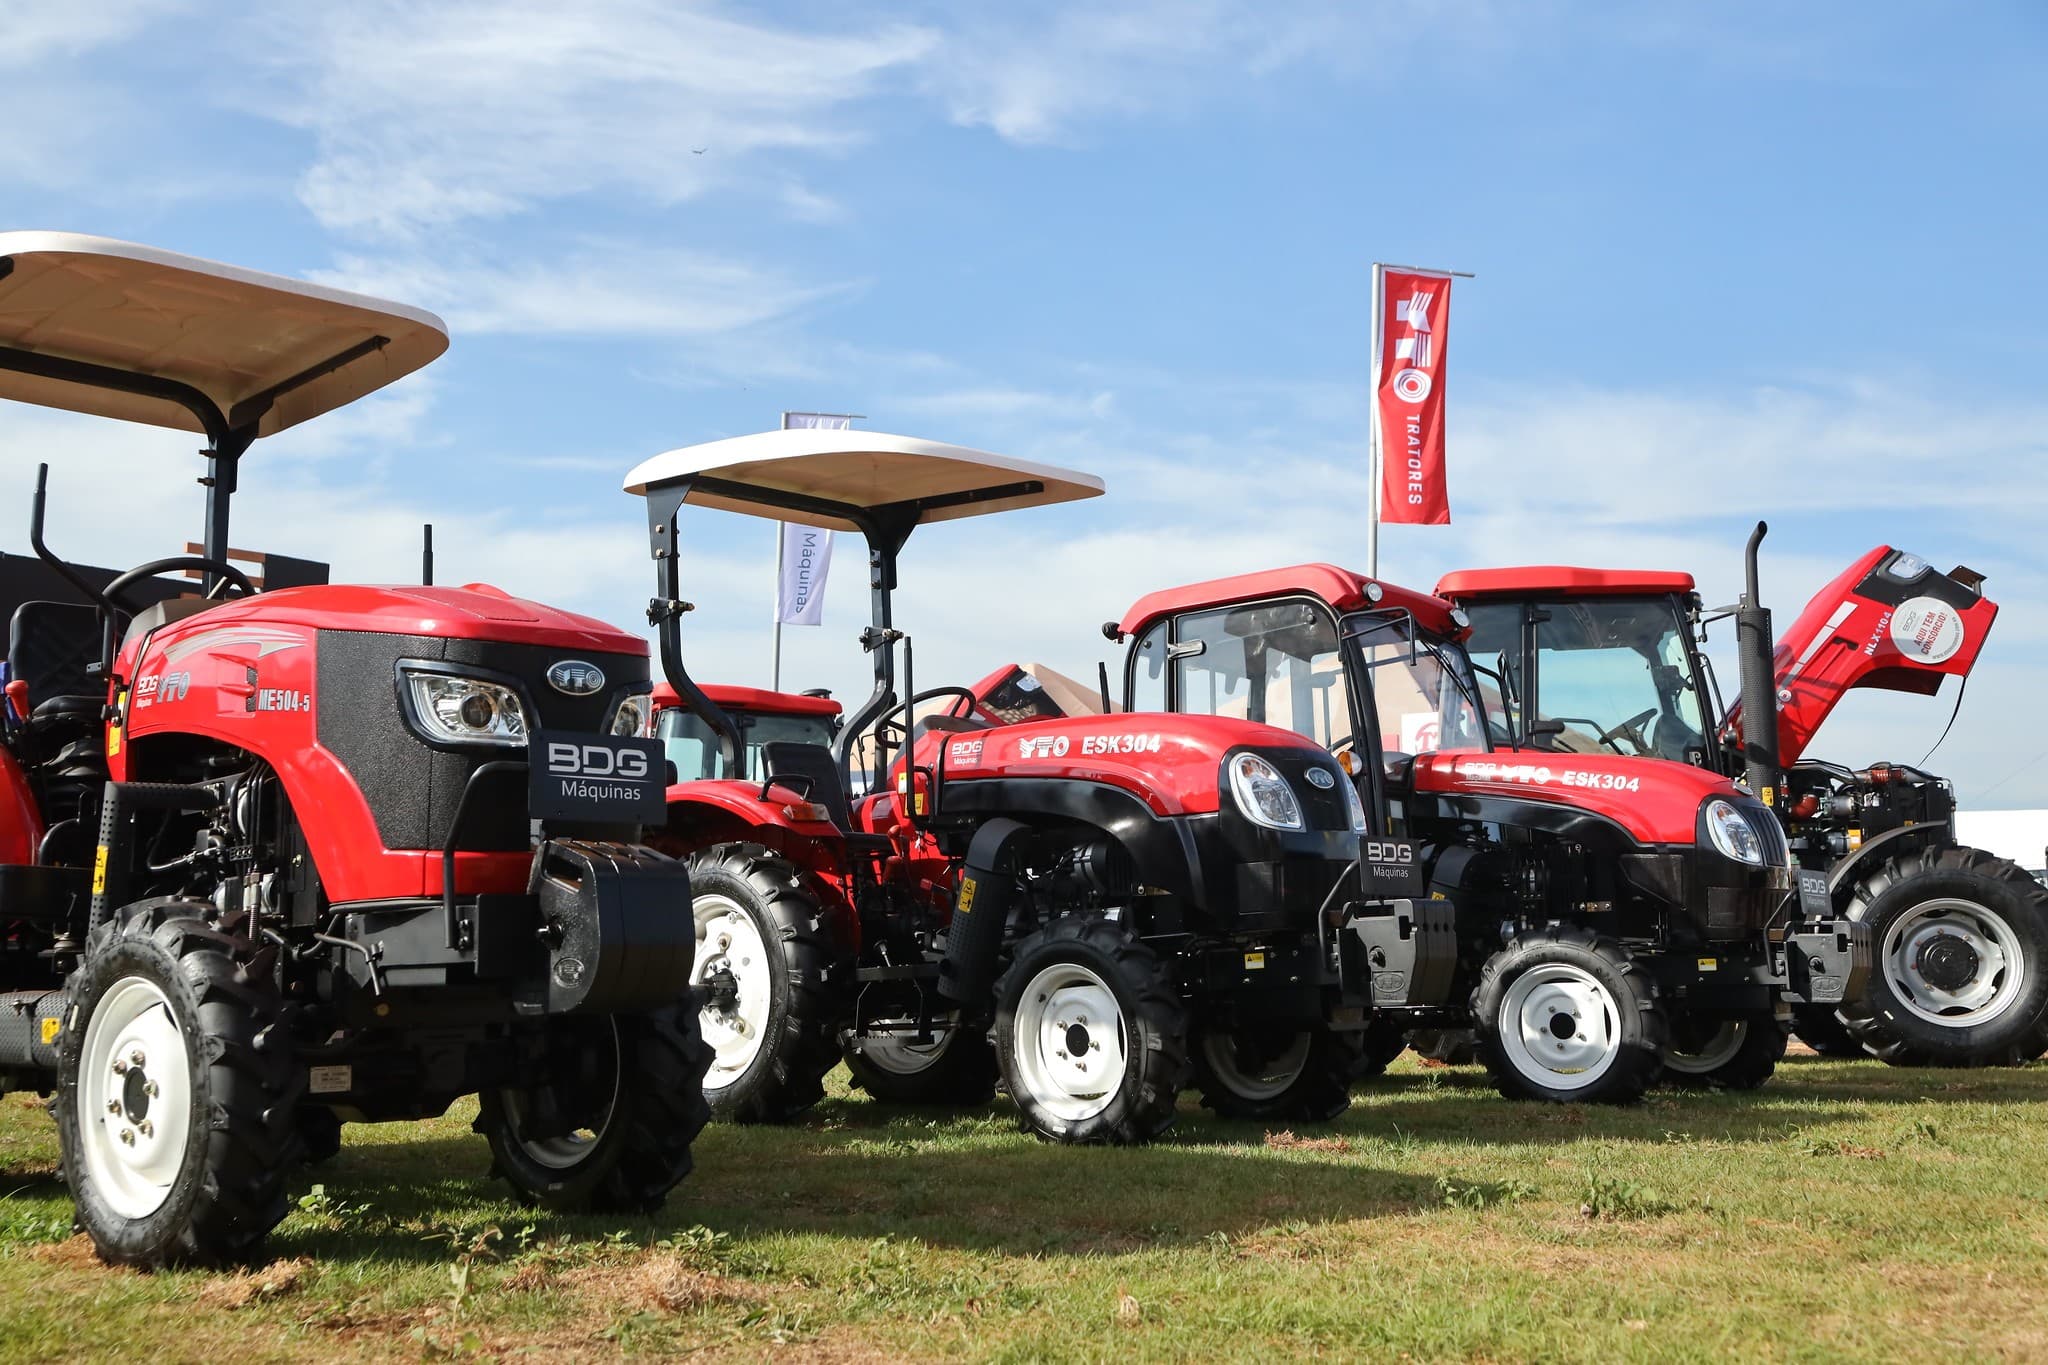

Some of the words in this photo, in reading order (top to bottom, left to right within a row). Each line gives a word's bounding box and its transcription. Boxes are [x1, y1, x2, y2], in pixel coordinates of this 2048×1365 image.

[1393, 291, 1433, 403] YTO
[1406, 414, 1422, 505] TRATORES
[795, 533, 816, 614] Máquinas
[1864, 611, 1892, 655] NLX1104
[1914, 627, 1928, 646] AQUI
[1923, 611, 1936, 628] TEM
[156, 672, 190, 703] YTO
[258, 689, 310, 712] ME504-5
[952, 740, 983, 755] BDG
[1019, 736, 1069, 758] YTO
[1082, 734, 1160, 755] ESK304
[549, 743, 647, 776] BDG
[562, 780, 640, 802] Máquinas
[1562, 770, 1640, 792] ESK304
[1367, 842, 1412, 863] BDG
[1373, 866, 1409, 880] Máquinas
[1802, 878, 1825, 894] BDG
